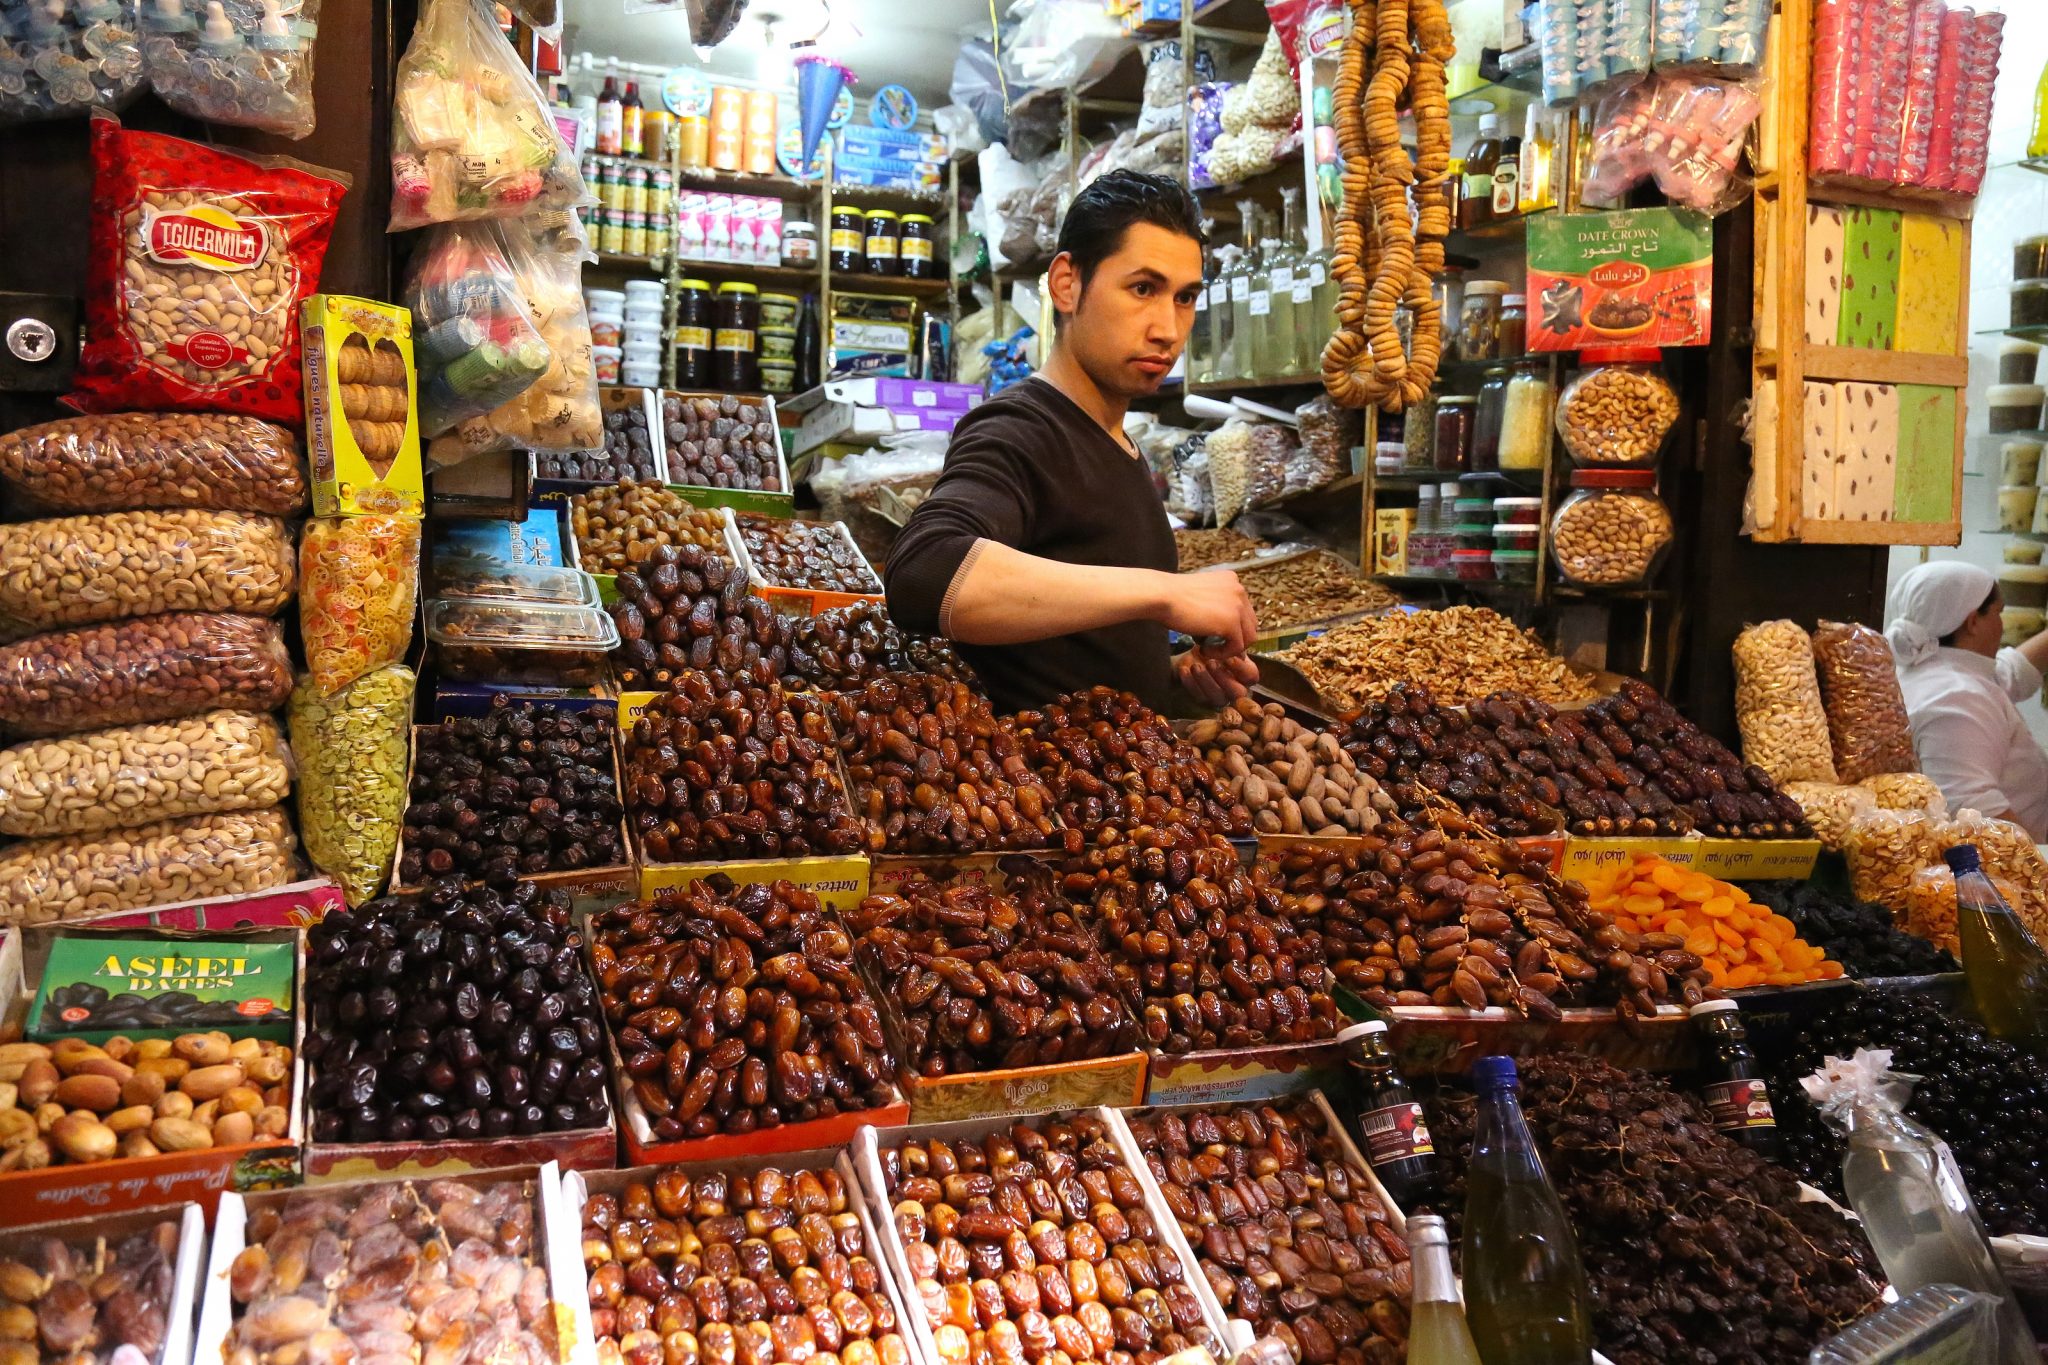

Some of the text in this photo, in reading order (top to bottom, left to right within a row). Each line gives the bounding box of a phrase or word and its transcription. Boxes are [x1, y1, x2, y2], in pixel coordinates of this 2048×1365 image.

[160, 222, 256, 260] TGUERMILA
[1578, 228, 1660, 243] DATE CROWN
[1580, 241, 1659, 259] تاج التمور
[1595, 270, 1619, 282] Lulu
[1621, 268, 1642, 282] لولو
[306, 347, 321, 393] figues
[311, 396, 328, 467] naturelle
[1667, 853, 1693, 864] Dattes
[592, 879, 626, 892] Dattes
[815, 879, 859, 893] Dattes
[93, 953, 263, 978] ASEEL
[129, 977, 235, 991] DATES
[1178, 1084, 1202, 1093] MAROC
[1235, 1079, 1247, 1089] LES
